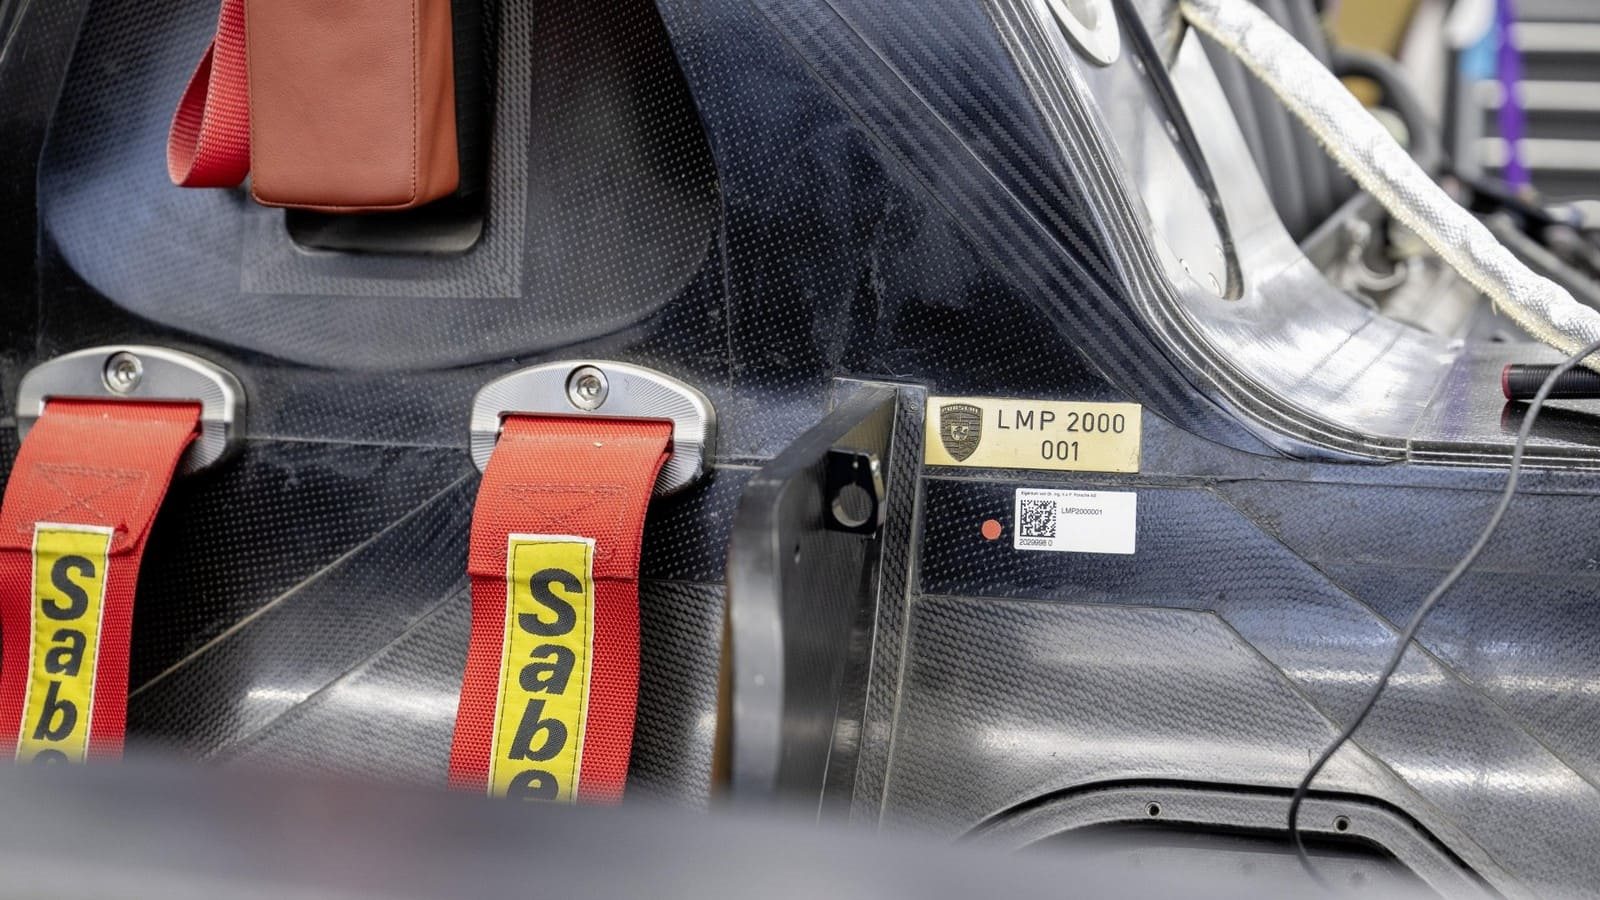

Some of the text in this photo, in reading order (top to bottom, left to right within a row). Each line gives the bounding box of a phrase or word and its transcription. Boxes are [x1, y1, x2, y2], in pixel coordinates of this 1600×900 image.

[998, 409, 1125, 433] LMP 2000
[1041, 439, 1079, 461] 001
[1061, 507, 1103, 515] LMP2000001
